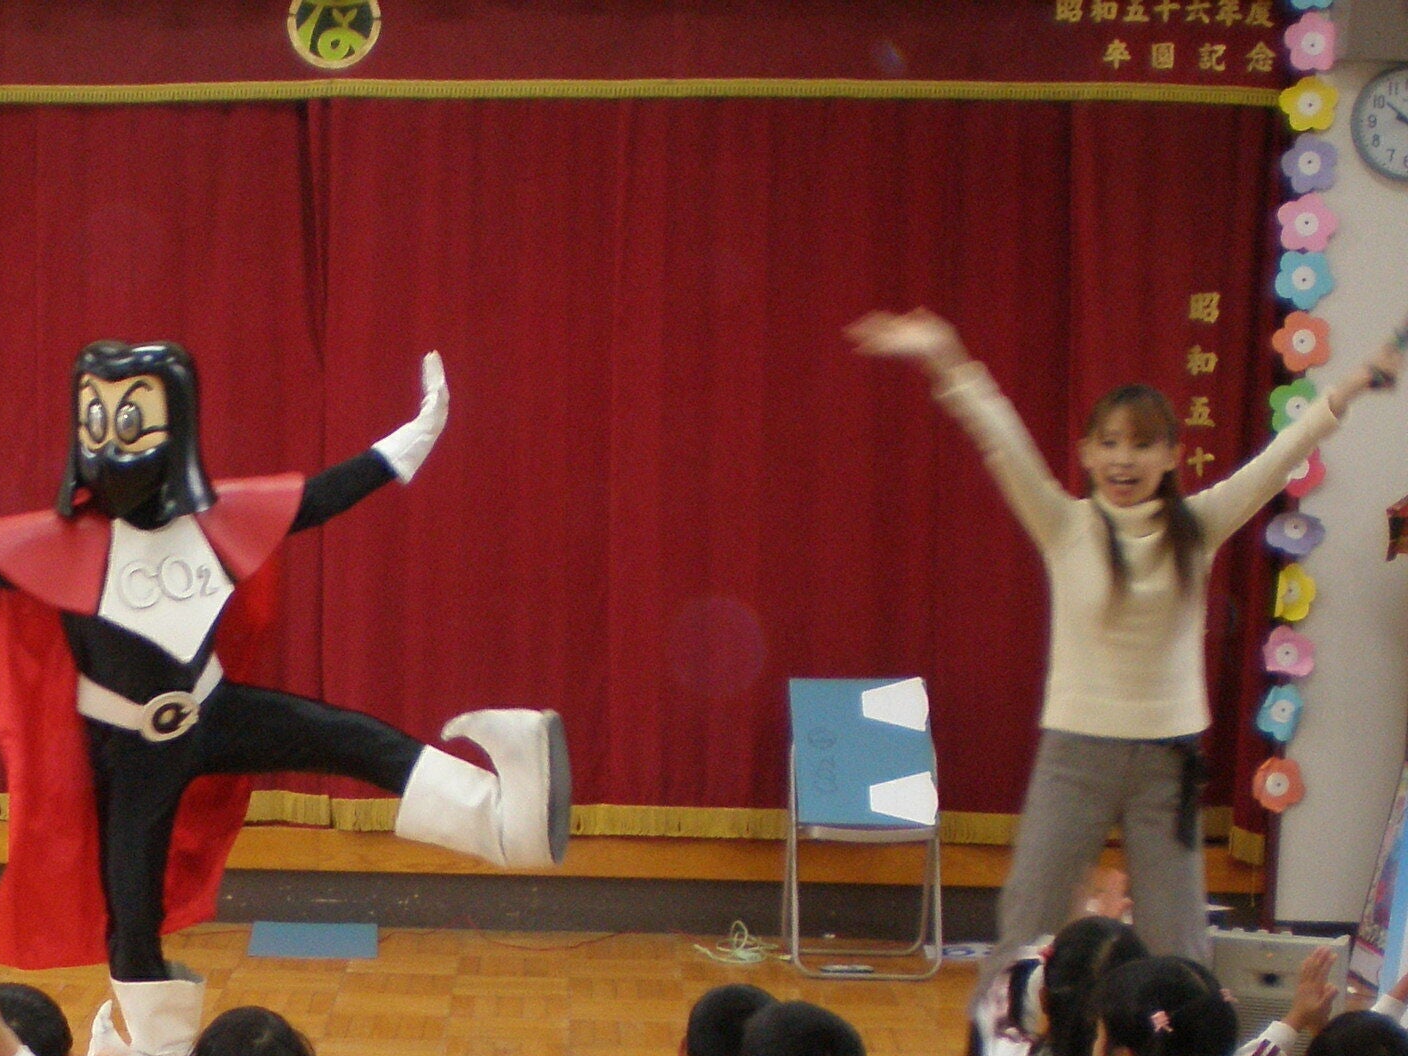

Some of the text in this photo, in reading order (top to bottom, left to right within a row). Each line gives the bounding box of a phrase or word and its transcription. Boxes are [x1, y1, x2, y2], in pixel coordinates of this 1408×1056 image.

[1373, 95, 1385, 109] 10
[1367, 114, 1377, 128] 9
[1386, 148, 1396, 162] 7
